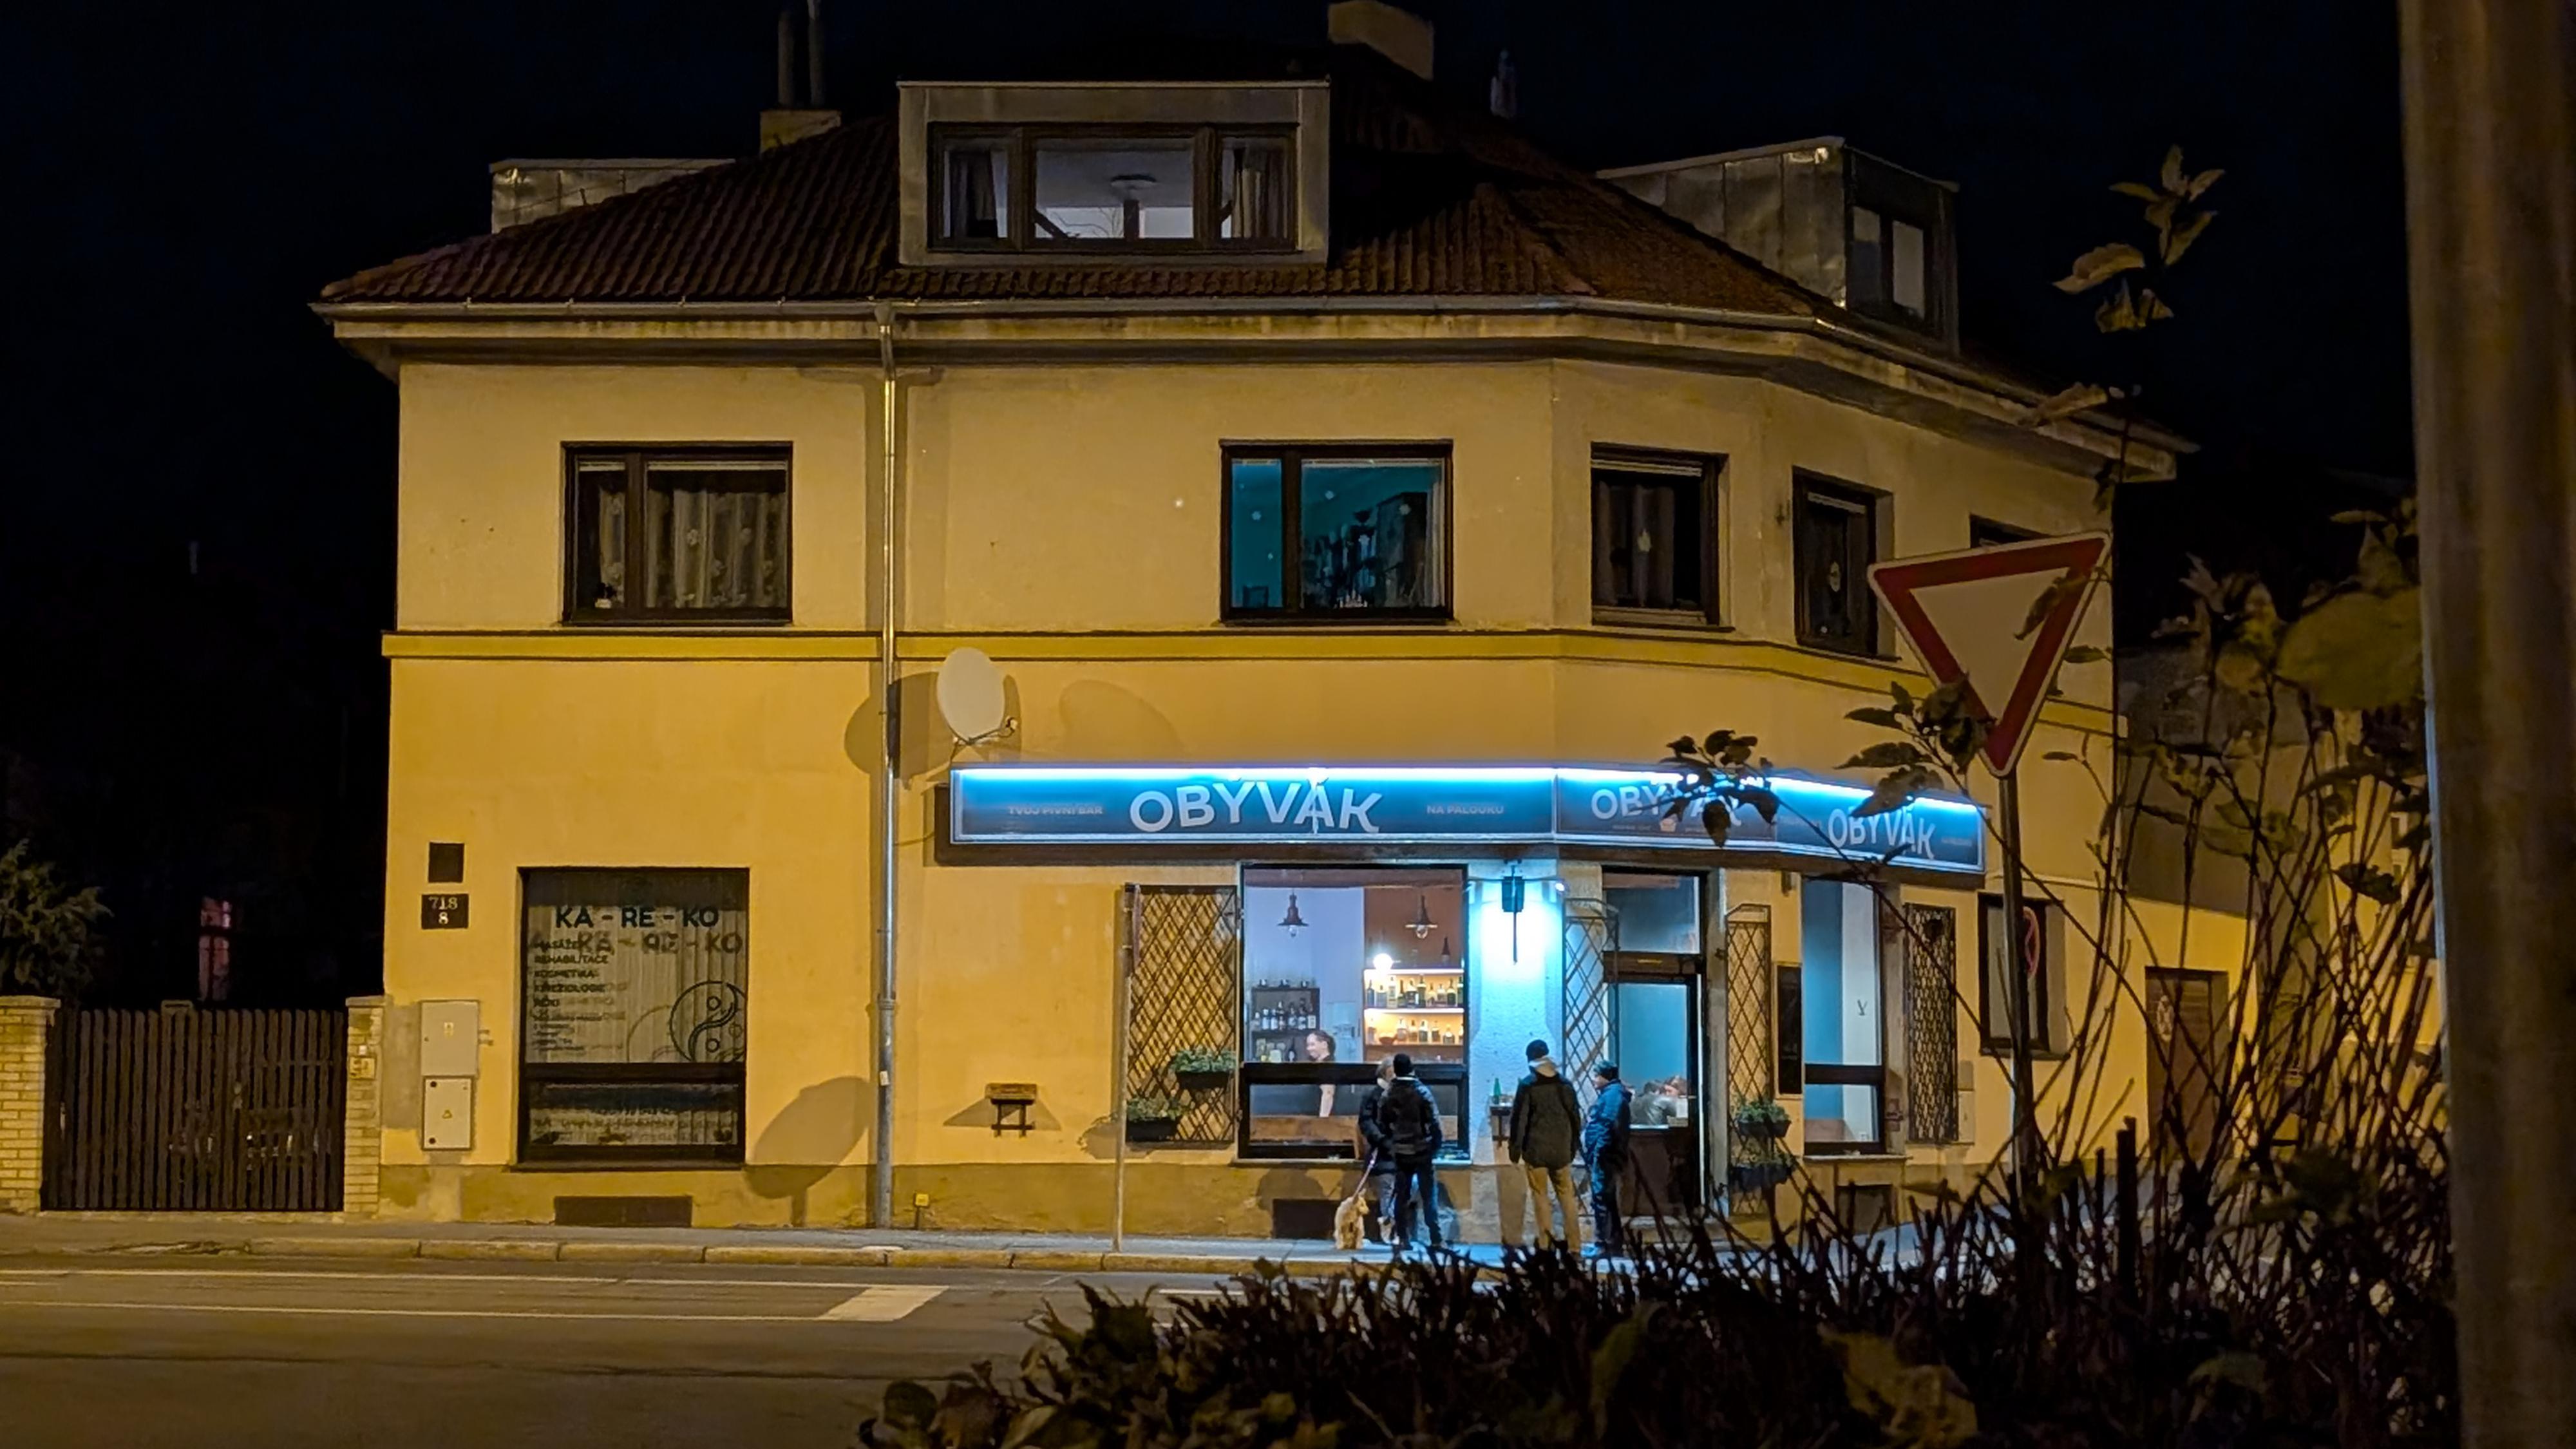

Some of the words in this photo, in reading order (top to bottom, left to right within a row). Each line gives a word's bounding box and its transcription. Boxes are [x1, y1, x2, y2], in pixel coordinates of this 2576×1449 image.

[1078, 806, 1103, 815] BAR
[1426, 805, 1444, 814] NA
[428, 896, 459, 910] 718
[438, 911, 449, 925] 8
